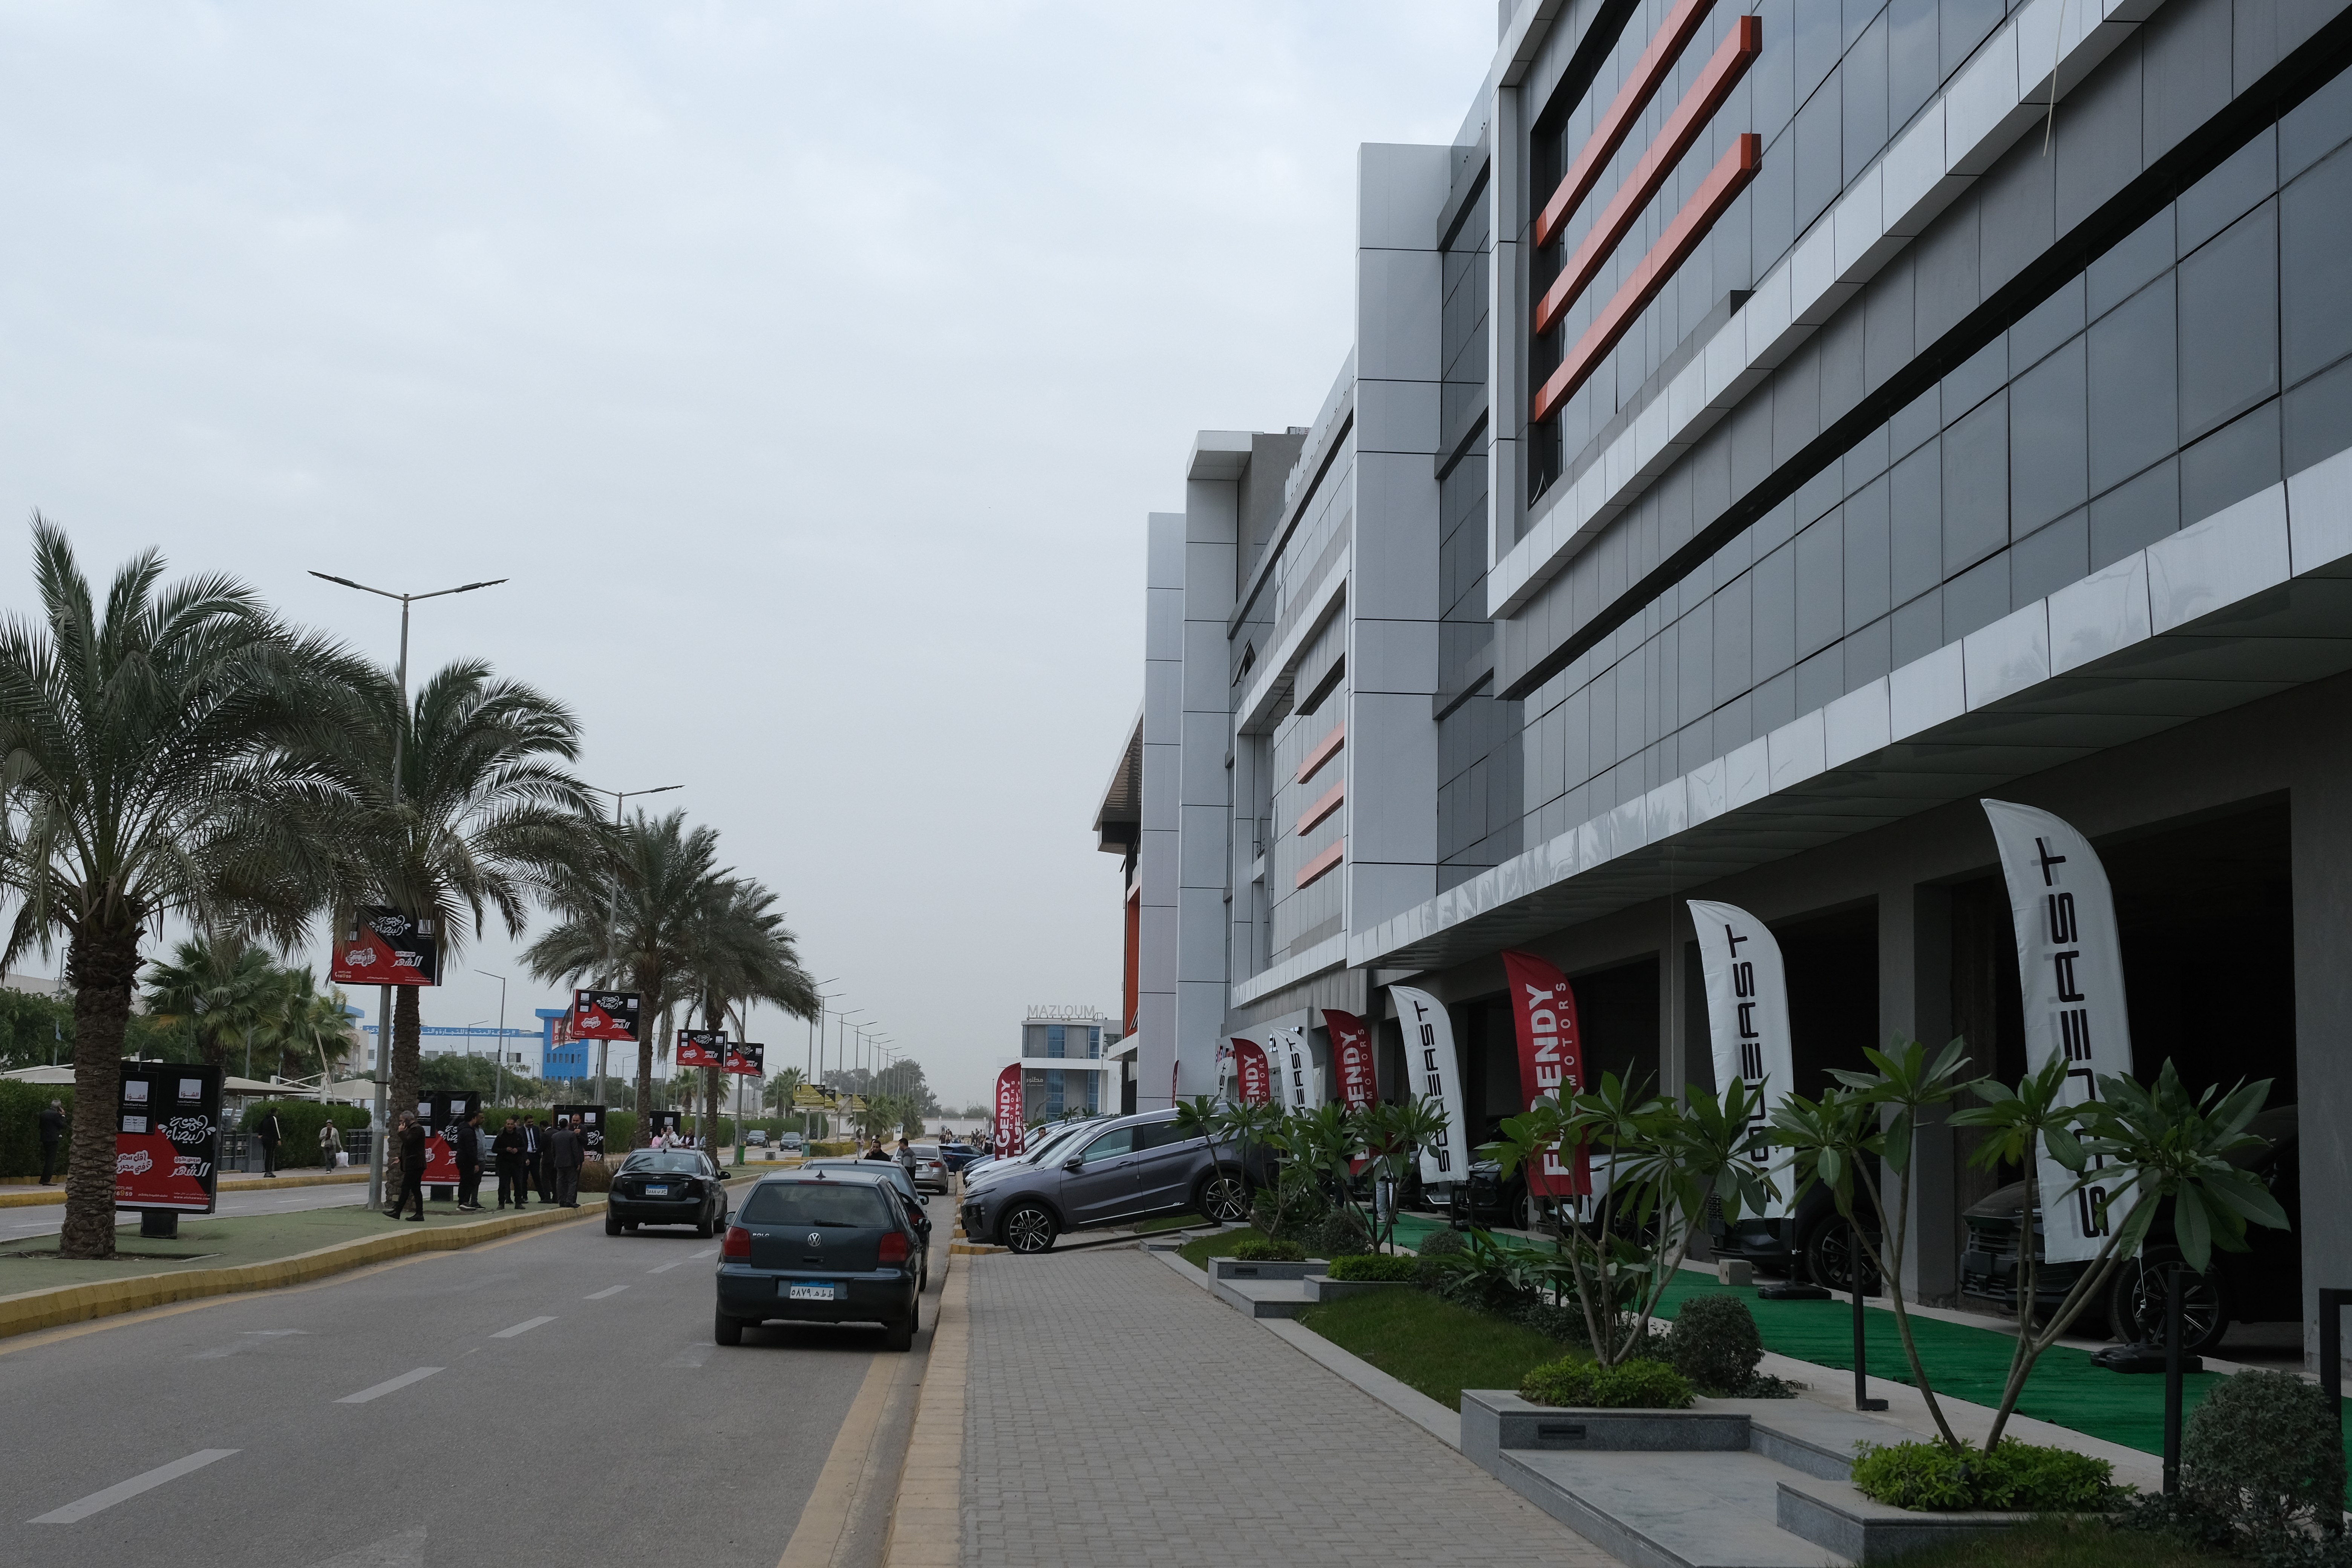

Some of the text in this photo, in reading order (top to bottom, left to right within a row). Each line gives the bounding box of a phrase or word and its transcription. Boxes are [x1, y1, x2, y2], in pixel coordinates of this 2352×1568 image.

[390, 956, 423, 967] الشهر
[1028, 1004, 1095, 1017] MAZLOUM
[1358, 1029, 1373, 1099] MOTORS
[996, 1079, 1011, 1148] GENDY
[134, 1152, 146, 1162] أقل
[135, 1163, 145, 1173] في
[167, 1162, 211, 1177] الشهر
[791, 1288, 811, 1297] ٥٨٧٩
